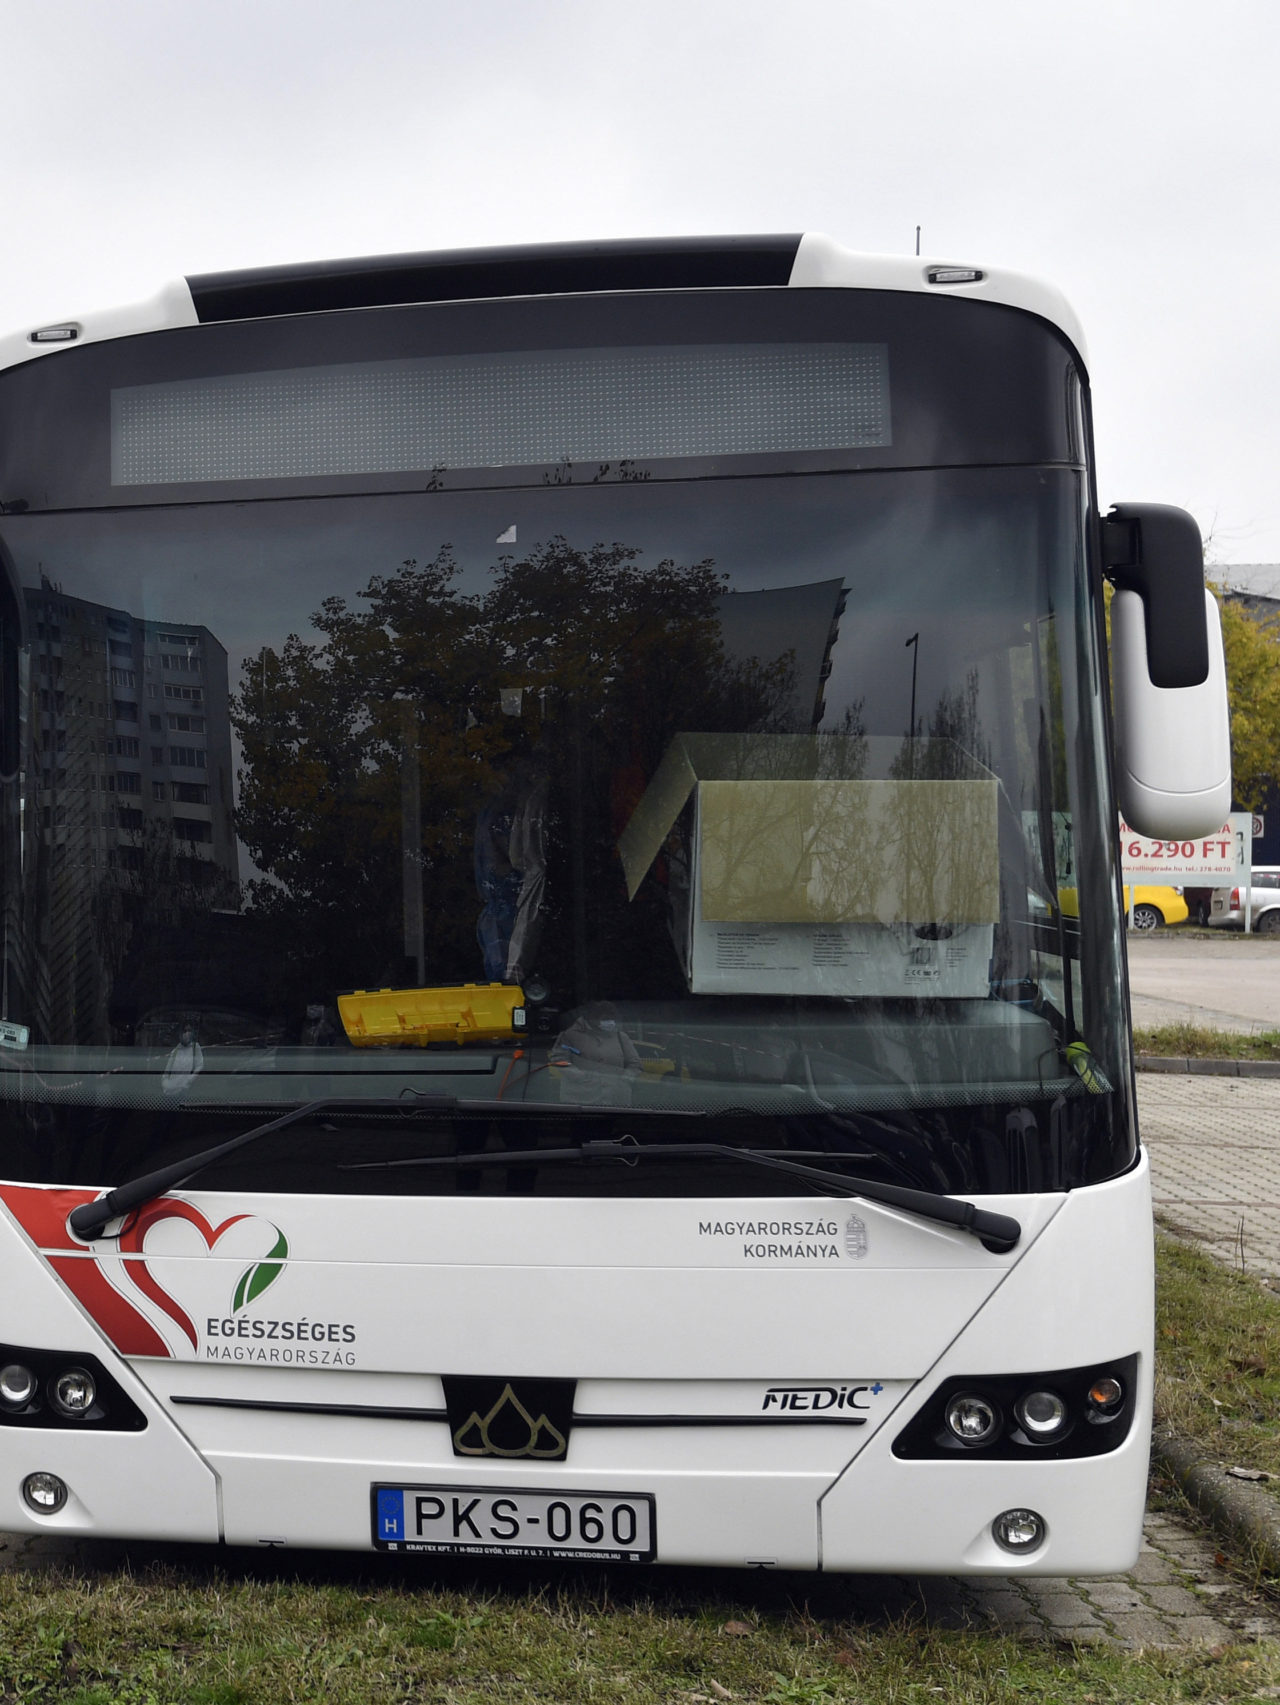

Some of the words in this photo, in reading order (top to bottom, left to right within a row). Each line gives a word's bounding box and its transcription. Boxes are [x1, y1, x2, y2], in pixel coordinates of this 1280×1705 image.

[1202, 841, 1231, 858] FT
[698, 1218, 838, 1236] MAGYARORSZÁG
[744, 1241, 840, 1258] KORMÁNYA
[207, 1314, 356, 1343] EGÉSZSÉGES
[206, 1345, 356, 1366] MAGYARORSZÁG
[385, 1518, 397, 1533] H
[415, 1496, 637, 1545] PKS-060
[406, 1543, 436, 1551] KRAVTEX
[552, 1550, 621, 1560] WWW.CREDOBUS.HU
